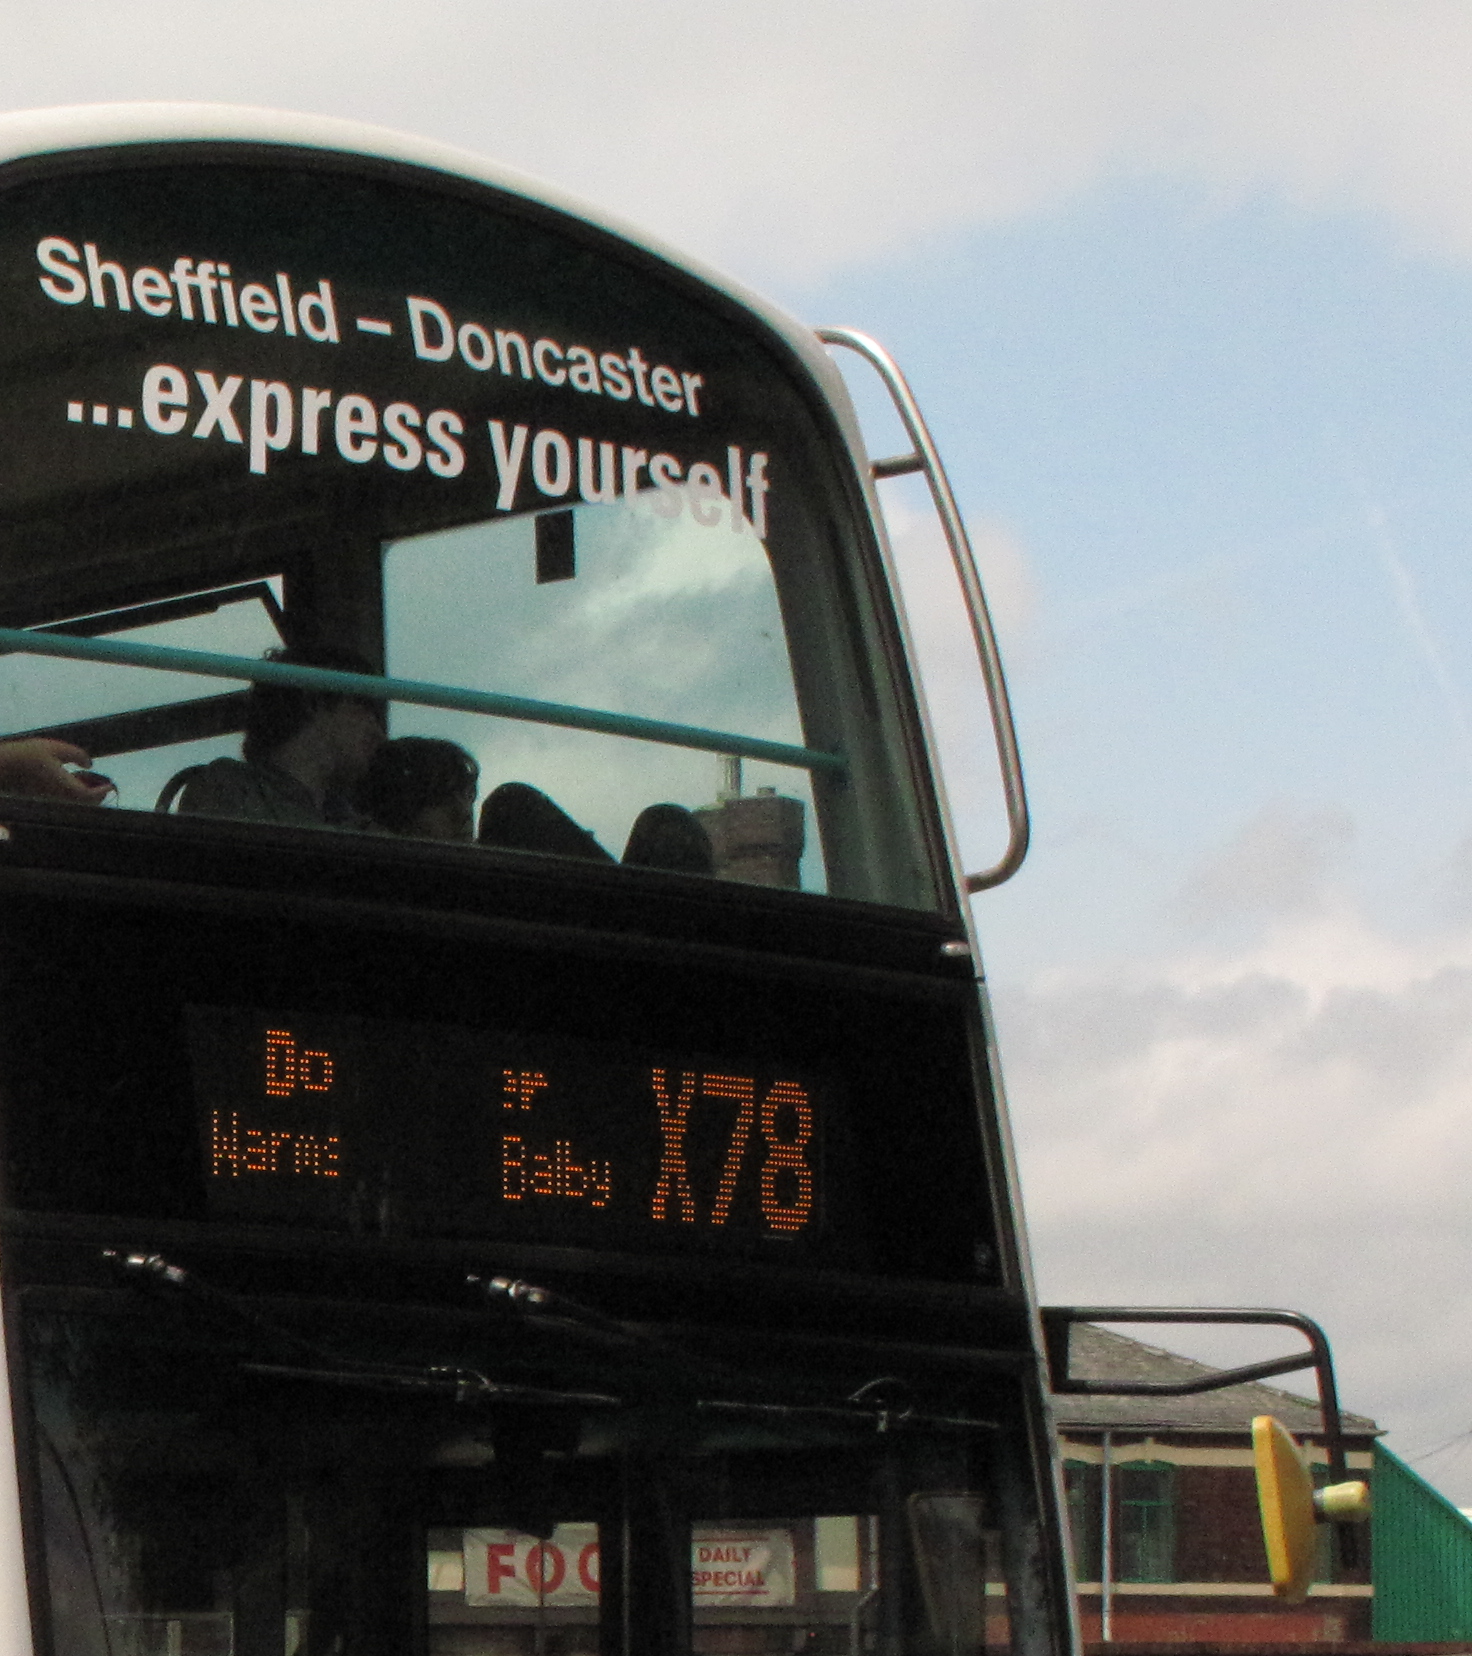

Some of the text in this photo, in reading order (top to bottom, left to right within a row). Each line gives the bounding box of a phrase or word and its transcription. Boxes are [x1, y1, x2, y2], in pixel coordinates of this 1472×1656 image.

[36, 237, 340, 344] Sheffield
[408, 297, 704, 418] Doncaster
[488, 420, 770, 540] yourself
[652, 1067, 813, 1231] X78
[691, 1568, 766, 1588] SPECIAL
[699, 1546, 752, 1563] DAILY
